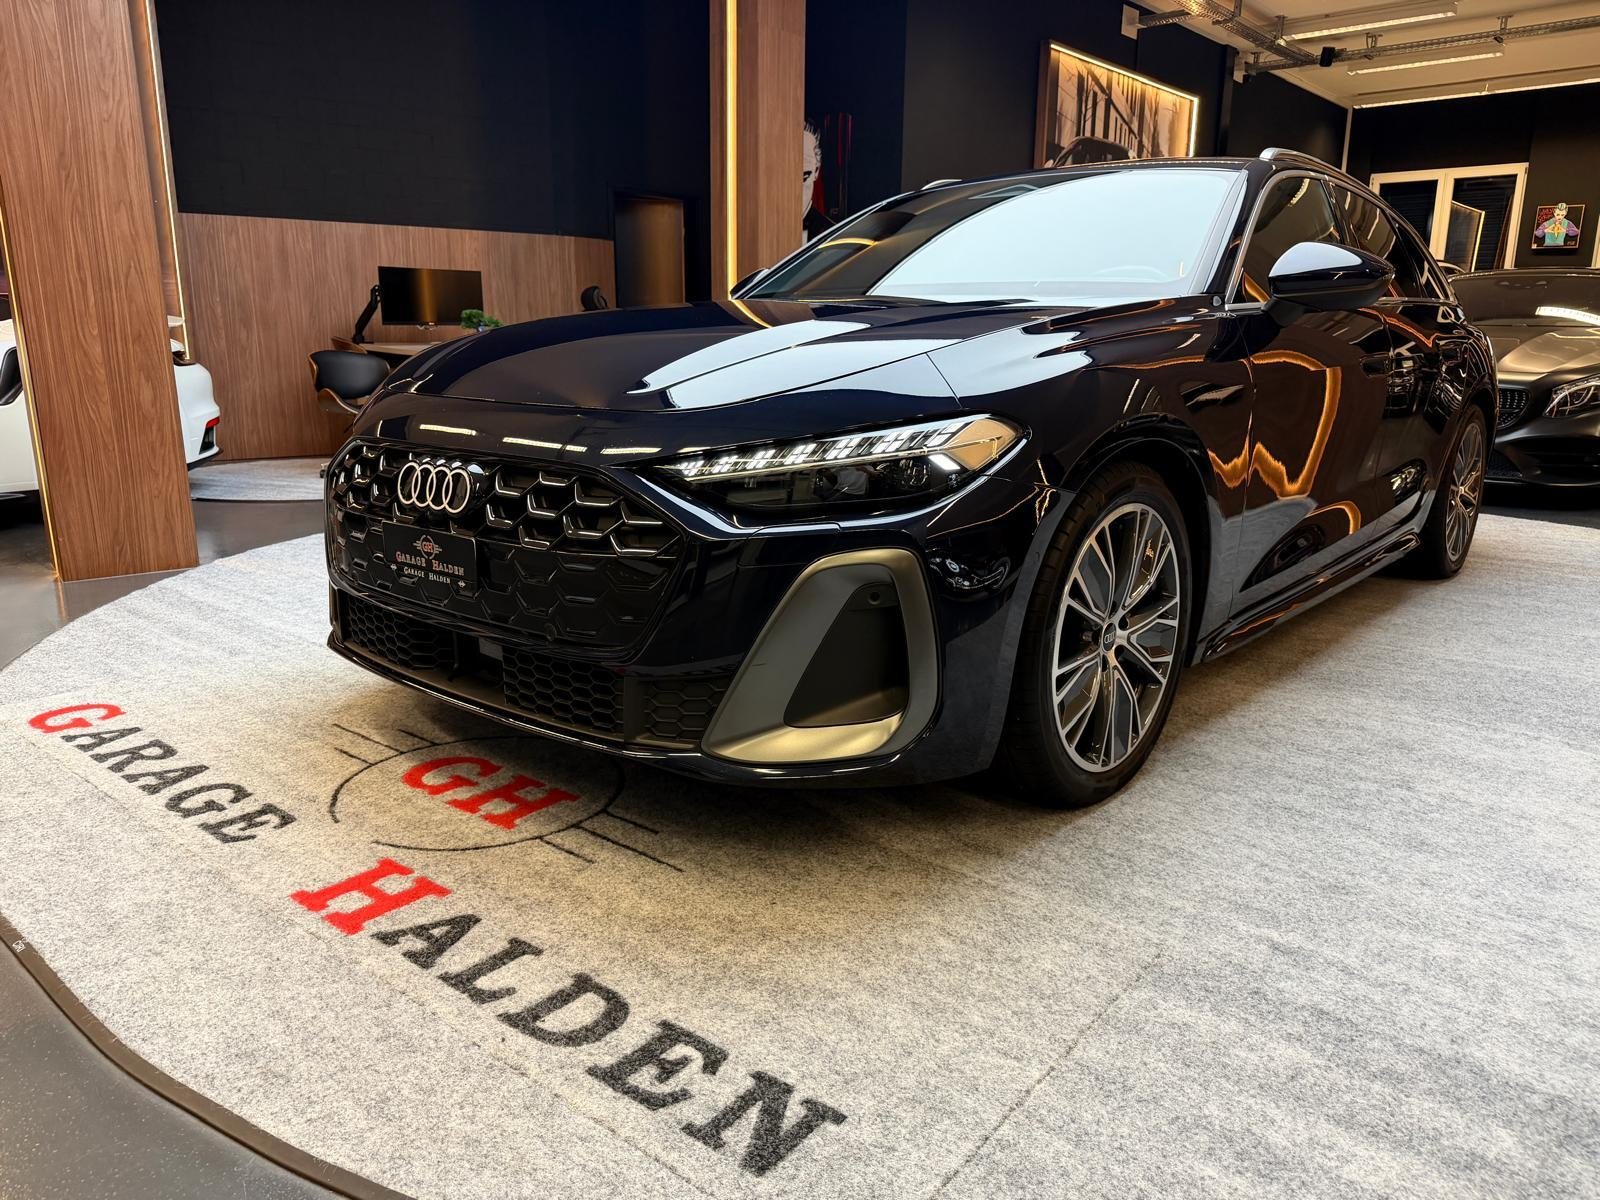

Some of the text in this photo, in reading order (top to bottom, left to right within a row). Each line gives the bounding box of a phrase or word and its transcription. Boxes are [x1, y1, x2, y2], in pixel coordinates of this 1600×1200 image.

[395, 551, 464, 576] GARAGE HALDEN
[403, 566, 451, 584] GARAGE HALDEN
[402, 756, 580, 829] GH
[28, 702, 848, 1177] GARAGE HALDEN
